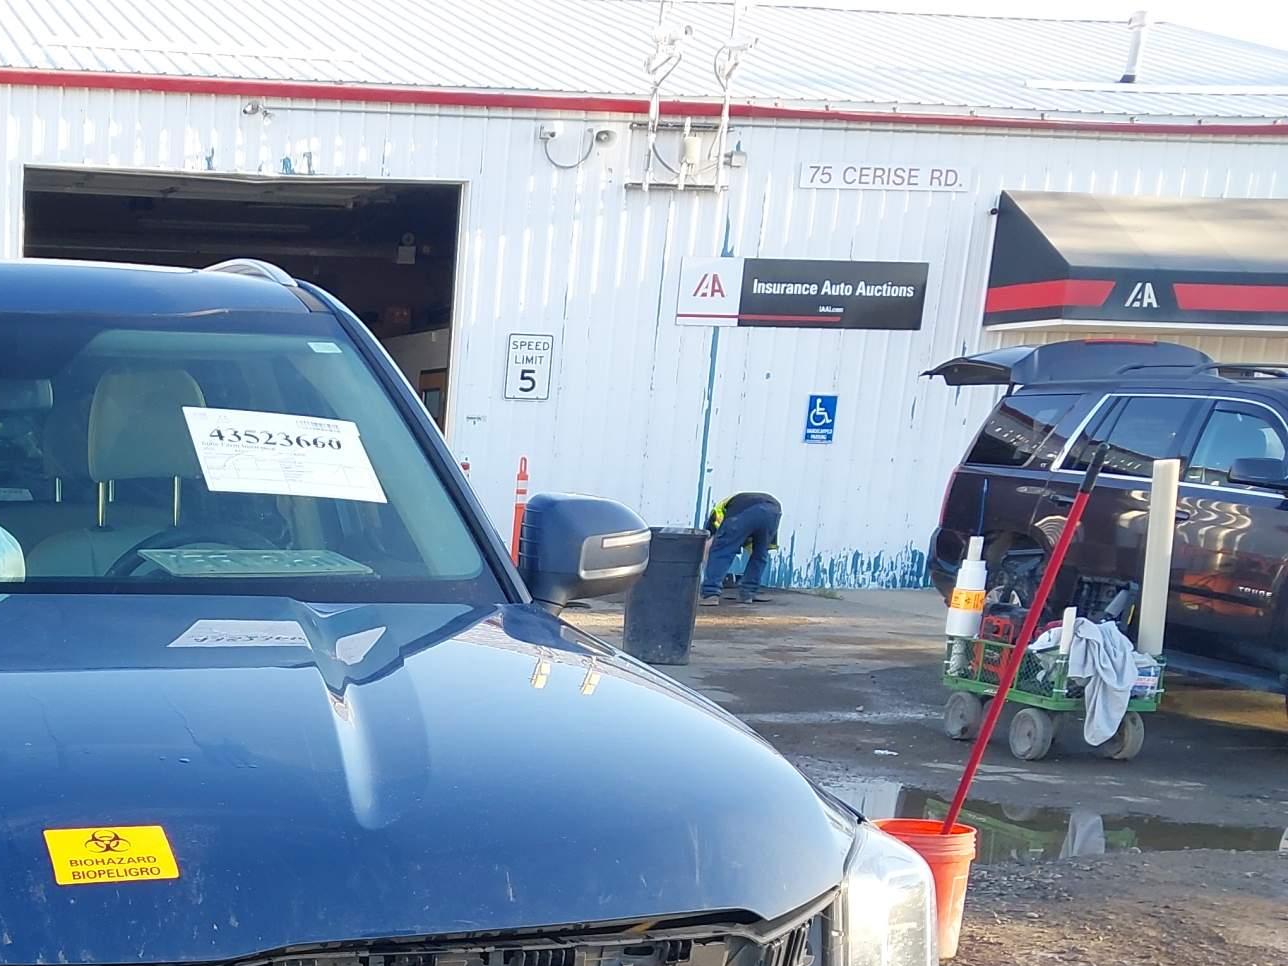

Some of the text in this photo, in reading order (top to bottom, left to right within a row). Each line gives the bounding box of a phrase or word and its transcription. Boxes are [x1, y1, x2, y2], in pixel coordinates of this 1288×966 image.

[808, 165, 963, 188] 75 CERISE RD.
[752, 278, 915, 298] Insurance Auto Auctions
[511, 340, 550, 351] SPEED
[514, 354, 545, 365] LIMIT
[518, 368, 537, 393] 5
[209, 427, 343, 450] 43523660
[69, 855, 157, 867] BIOHAZARD
[72, 866, 161, 880] BIOPELIGRO
